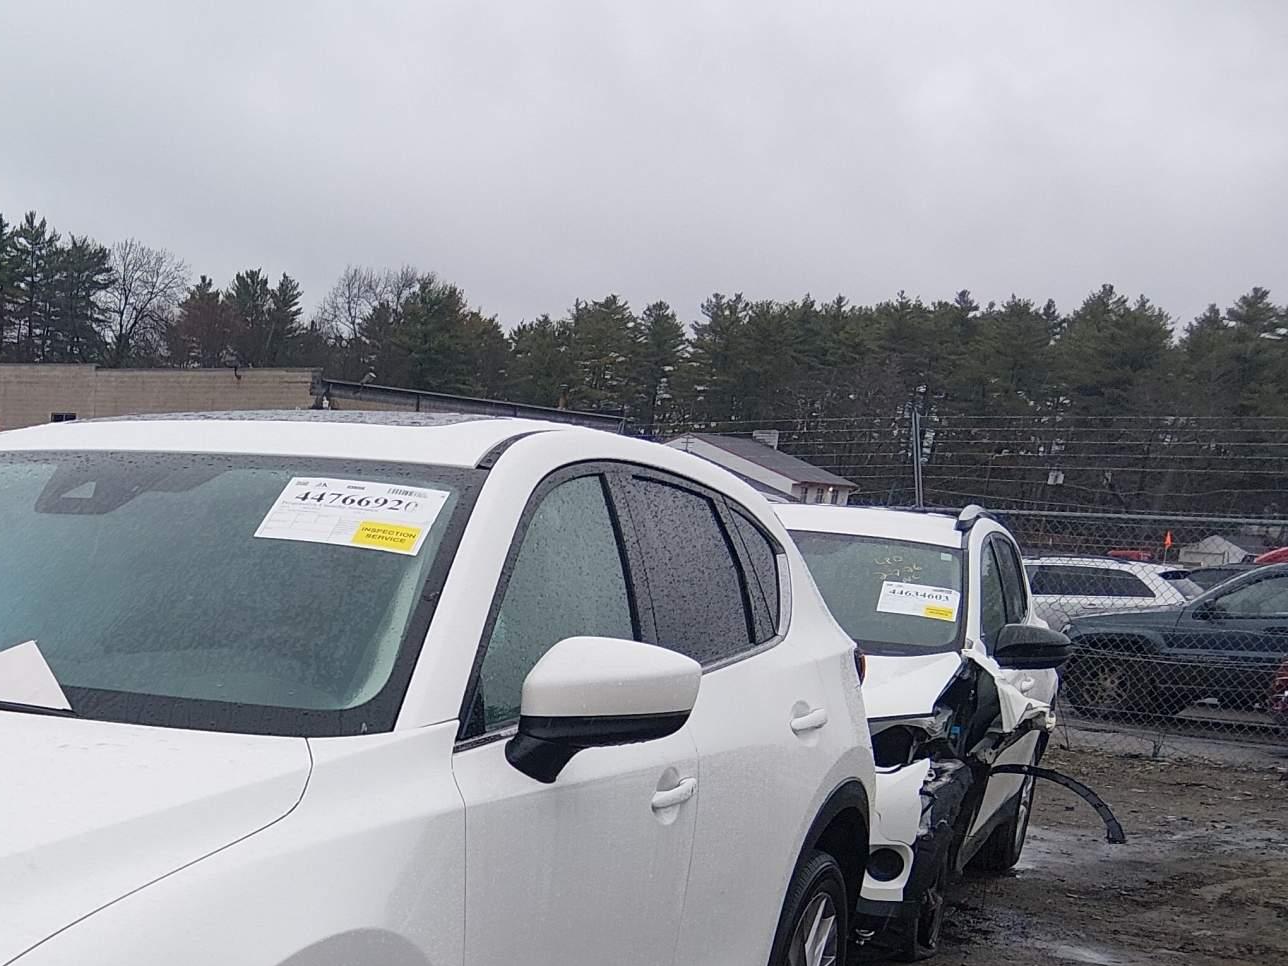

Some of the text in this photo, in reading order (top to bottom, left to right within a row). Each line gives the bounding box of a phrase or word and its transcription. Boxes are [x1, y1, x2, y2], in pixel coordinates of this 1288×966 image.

[295, 490, 419, 513] 44766920
[361, 526, 417, 539] INSPECTION
[364, 533, 407, 544] SERVICE
